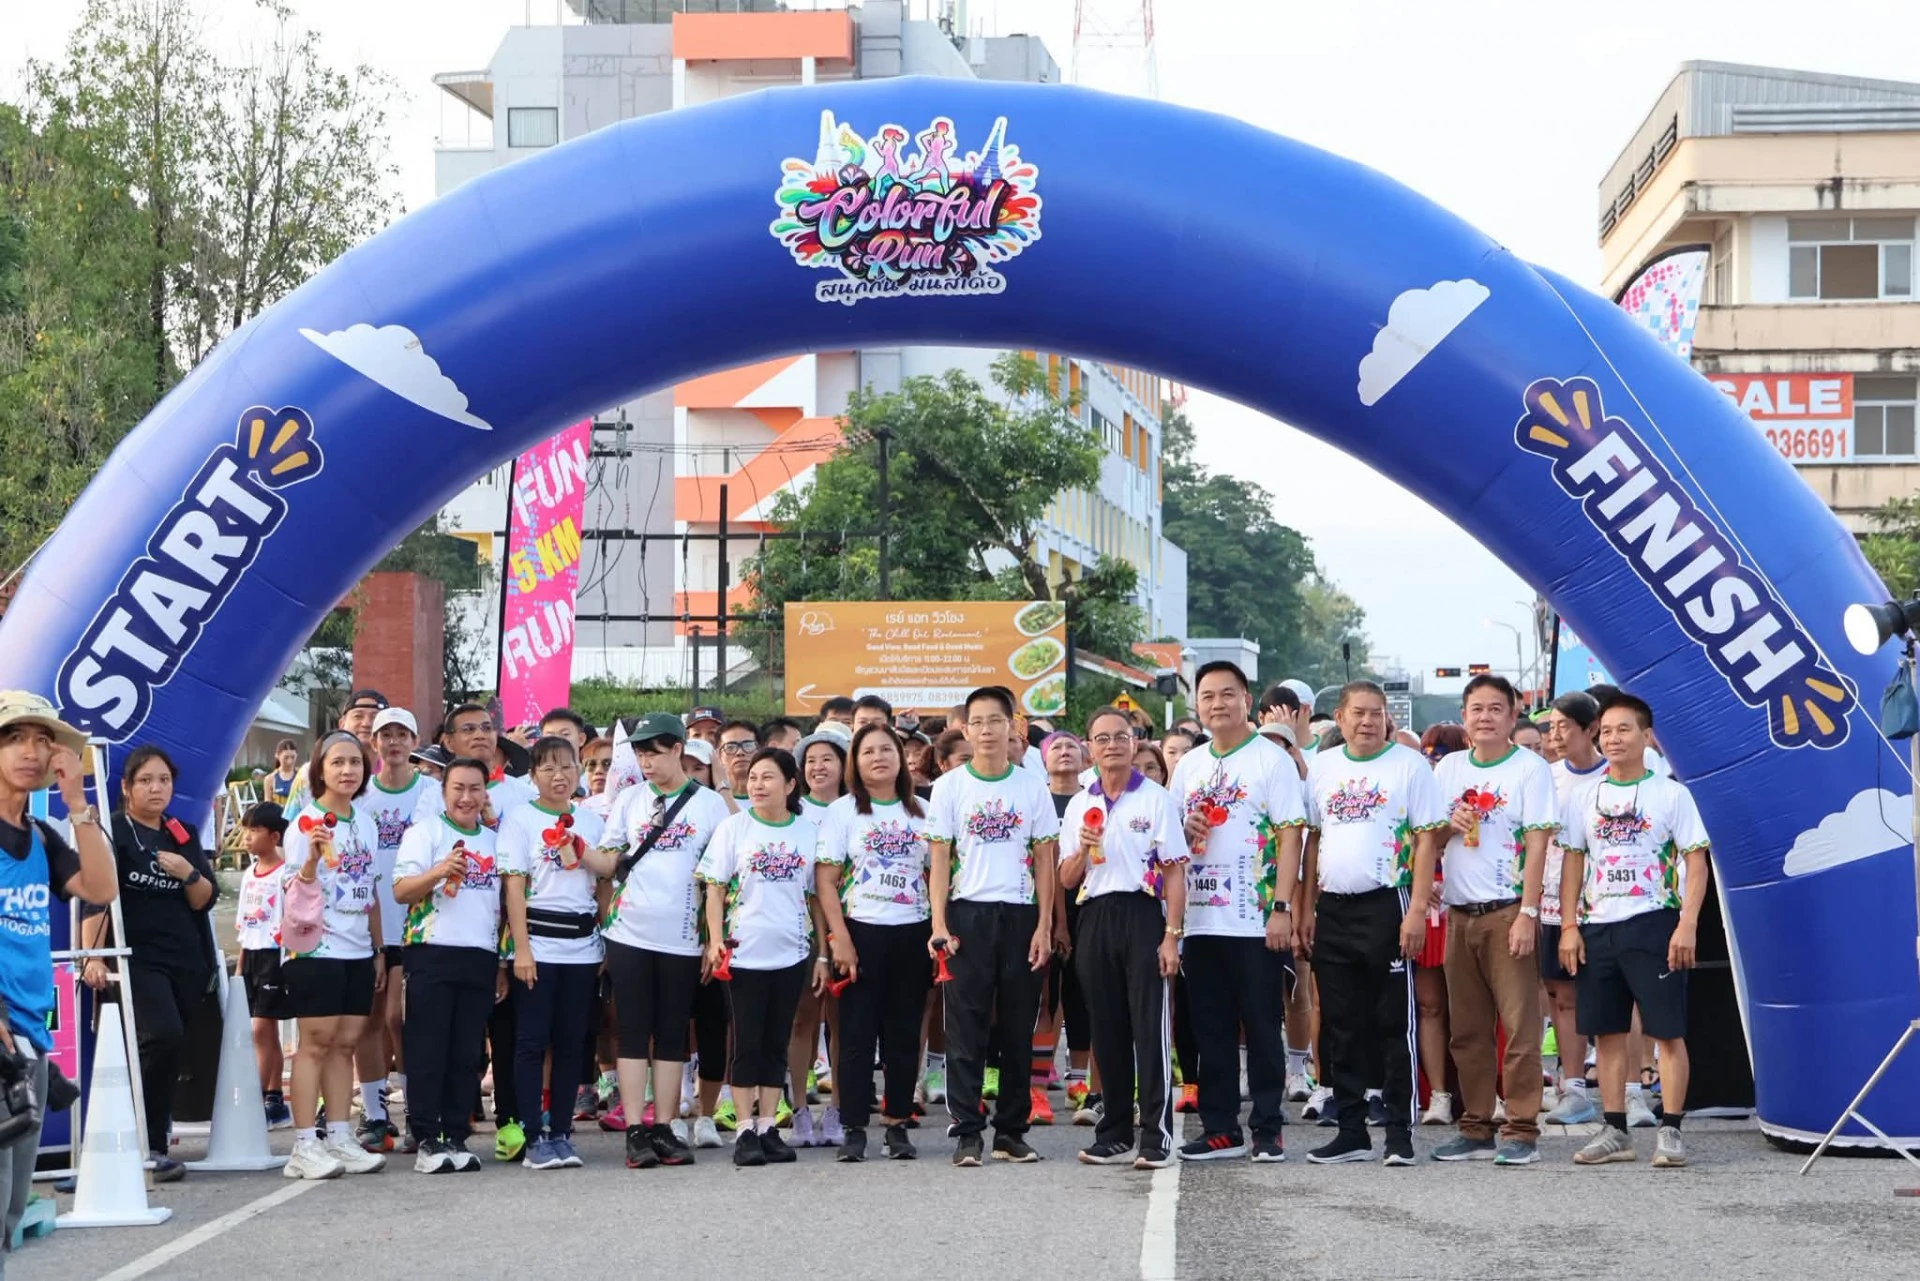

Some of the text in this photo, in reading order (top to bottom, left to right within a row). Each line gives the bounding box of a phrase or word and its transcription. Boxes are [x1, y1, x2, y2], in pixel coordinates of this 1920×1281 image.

[799, 181, 1005, 248] Colorful
[865, 231, 944, 280] Run
[1711, 380, 1842, 414] SALE
[513, 438, 587, 526] FUN
[510, 516, 581, 594] 5 KM
[1566, 431, 1806, 693] FINISH
[69, 457, 273, 730] START
[129, 871, 180, 889] OFFICIA
[352, 887, 368, 900] 1457
[880, 873, 907, 889] 1463
[1195, 878, 1217, 891] 1449
[1607, 868, 1636, 883] 5431
